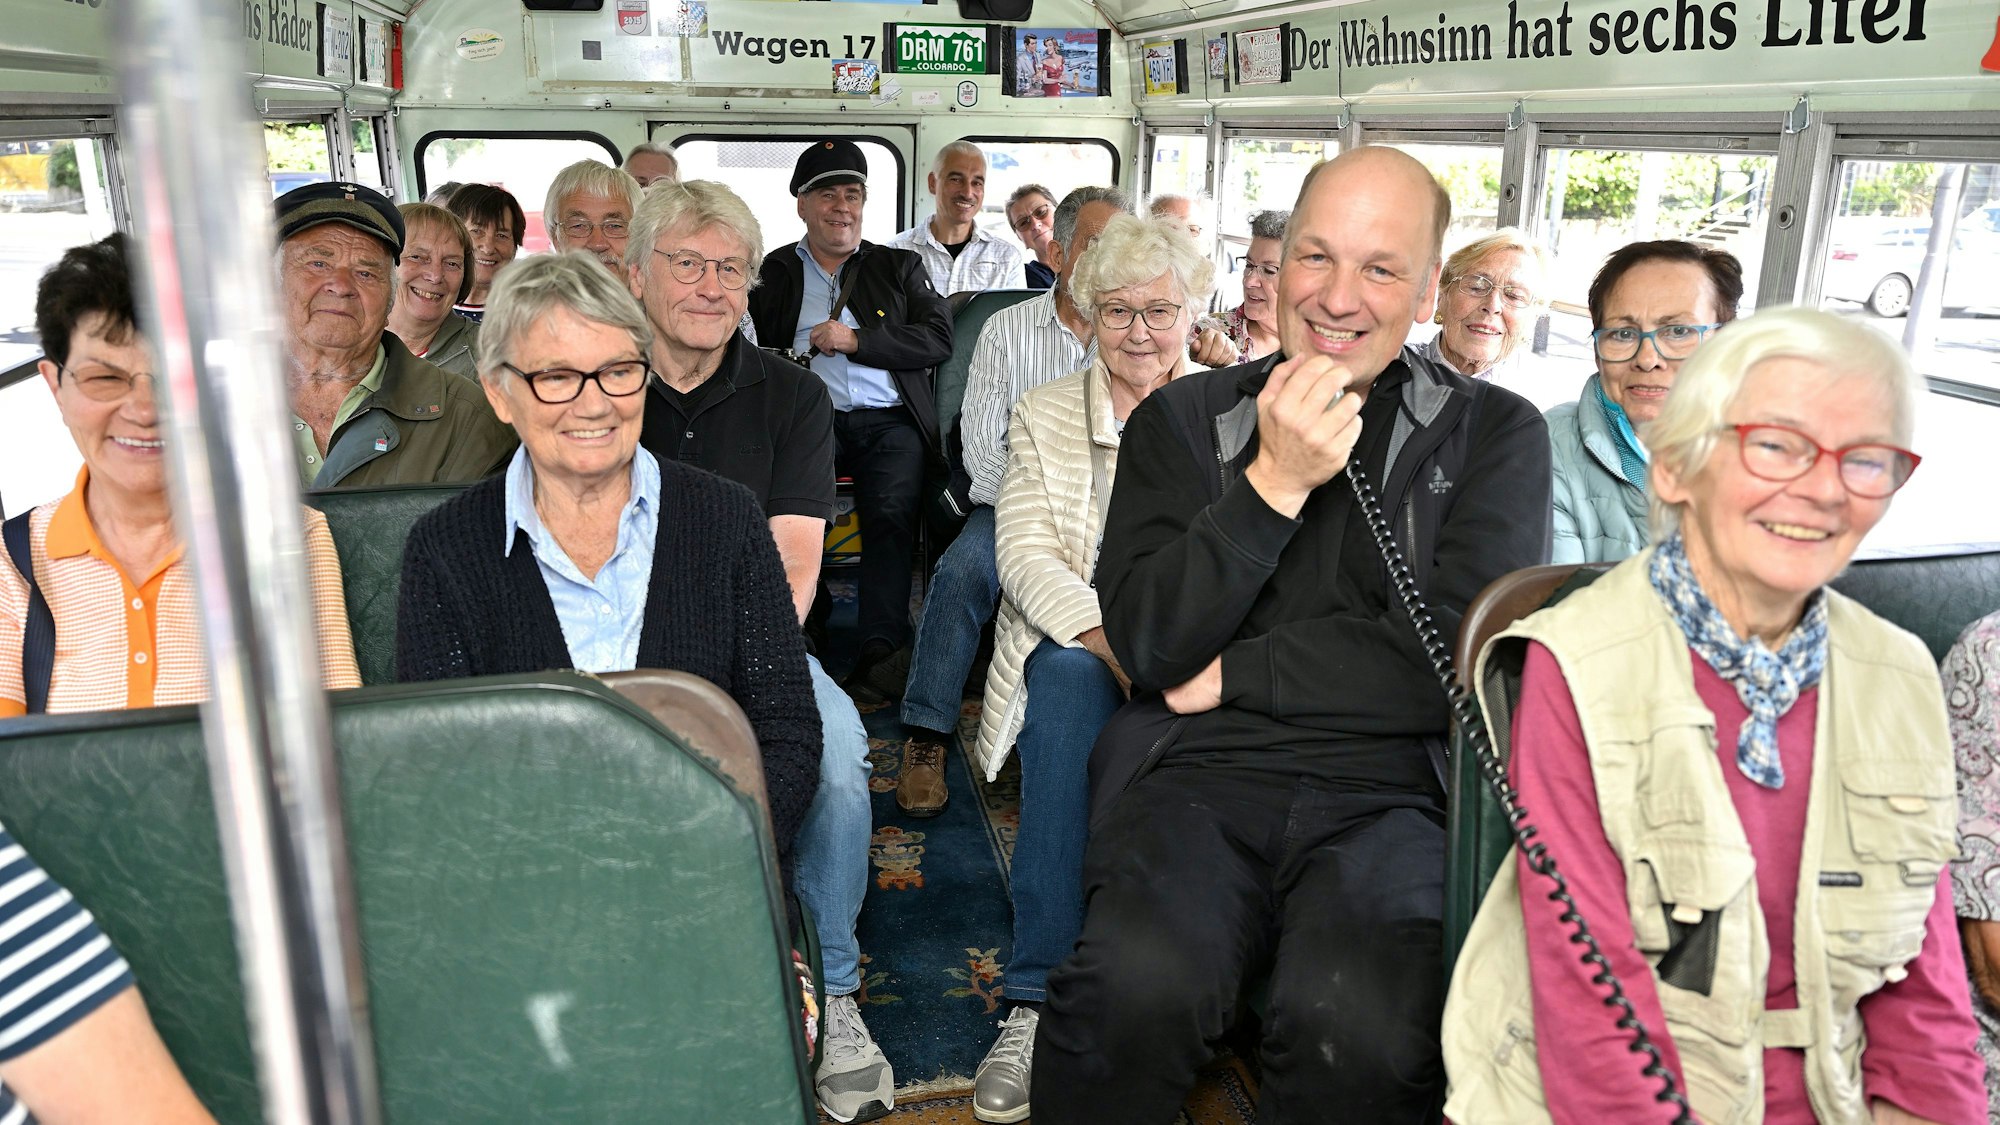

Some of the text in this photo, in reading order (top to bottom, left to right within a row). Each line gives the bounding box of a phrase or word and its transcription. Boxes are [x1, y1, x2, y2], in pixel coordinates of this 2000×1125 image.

[268, 0, 312, 52] Räder
[1290, 27, 1331, 71] Der
[1340, 12, 1492, 68] Wahnsinn
[1506, 0, 1573, 60] hat
[1588, 0, 1737, 56] sechs
[712, 31, 876, 64] Wagen 17
[902, 37, 983, 62] DRM 761
[917, 62, 966, 71] COLORADO
